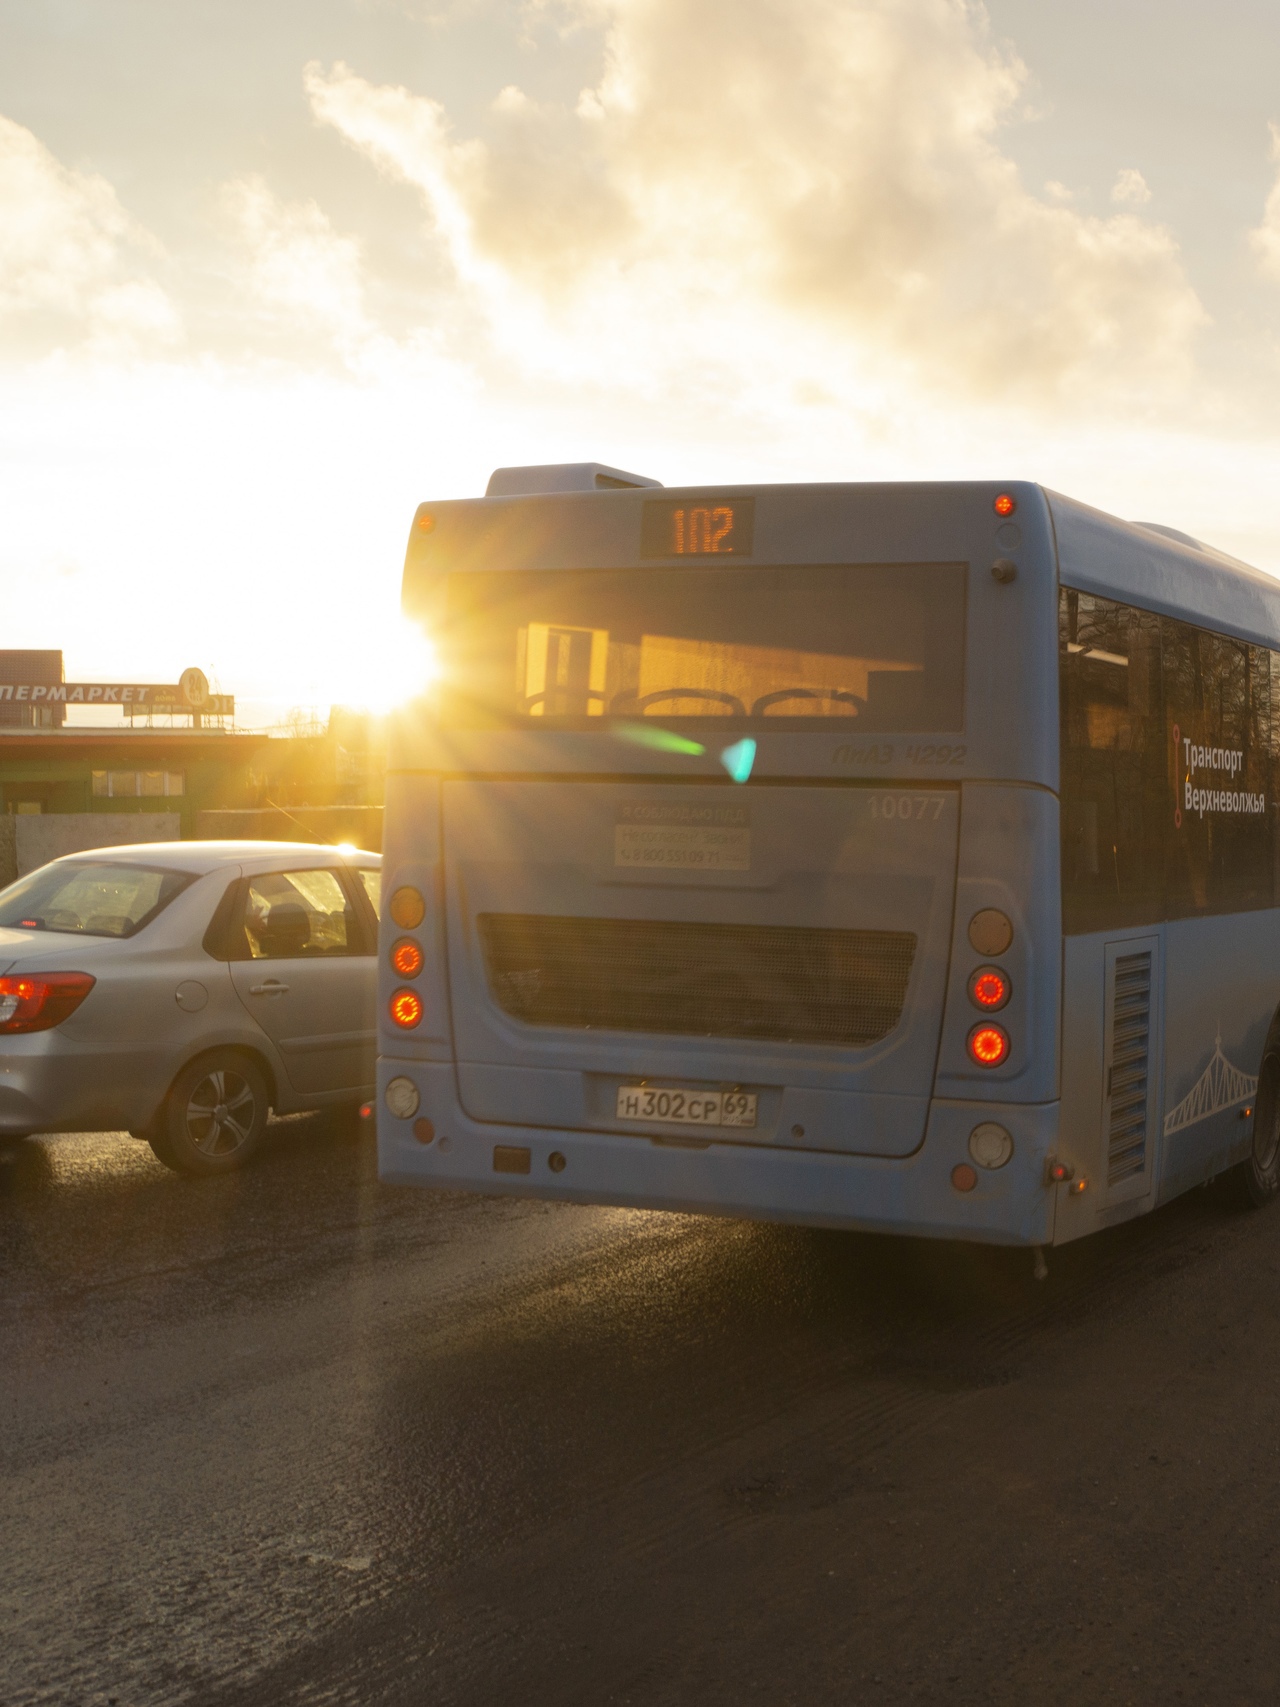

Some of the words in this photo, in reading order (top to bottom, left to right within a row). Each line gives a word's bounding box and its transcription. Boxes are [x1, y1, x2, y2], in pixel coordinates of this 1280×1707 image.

[674, 507, 733, 554] 102
[905, 744, 968, 766] 4292
[1183, 737, 1243, 779] Транспорт
[867, 795, 946, 820] 10077
[1185, 782, 1265, 819] Верхневолжья
[724, 1094, 748, 1115] 69
